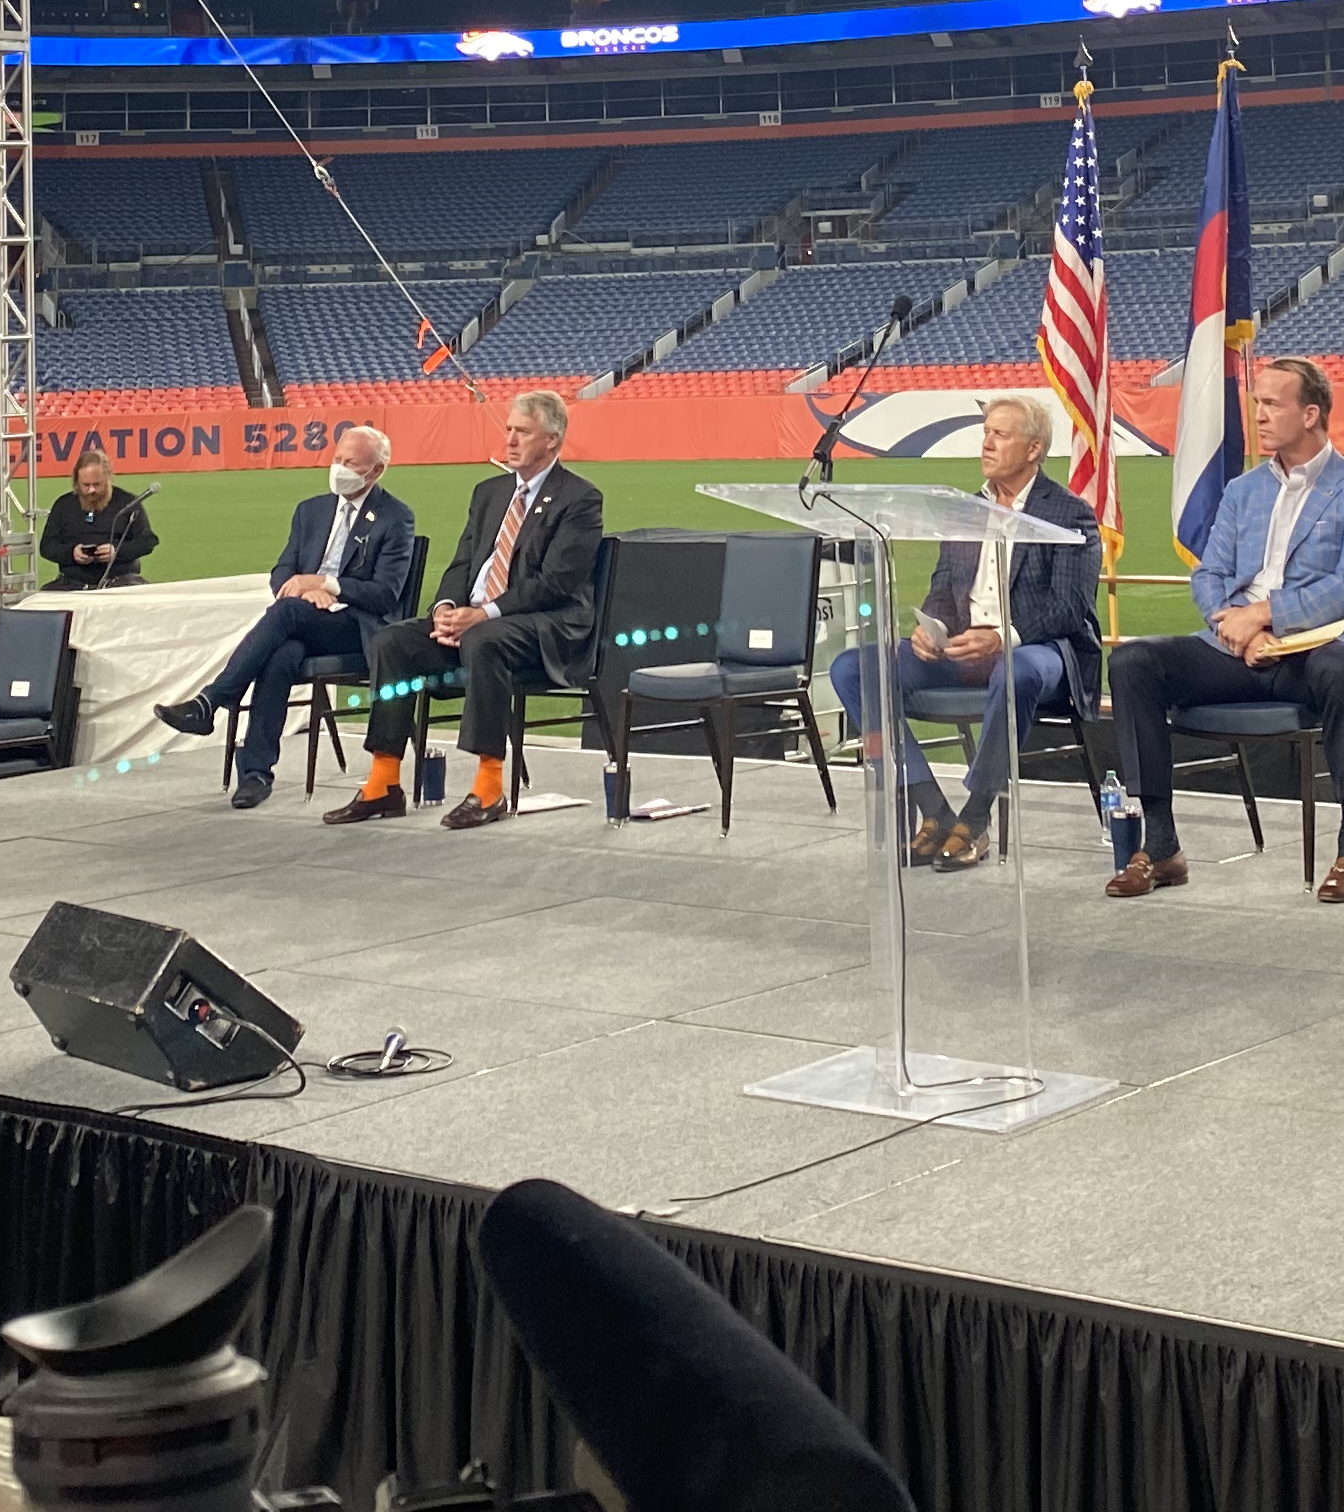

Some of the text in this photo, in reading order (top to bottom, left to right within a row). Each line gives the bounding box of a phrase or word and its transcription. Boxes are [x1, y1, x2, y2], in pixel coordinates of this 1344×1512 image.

[560, 25, 679, 48] BRONCOS
[1043, 95, 1060, 106] 119
[762, 114, 780, 125] 118
[419, 127, 438, 138] 118
[78, 133, 98, 144] 117
